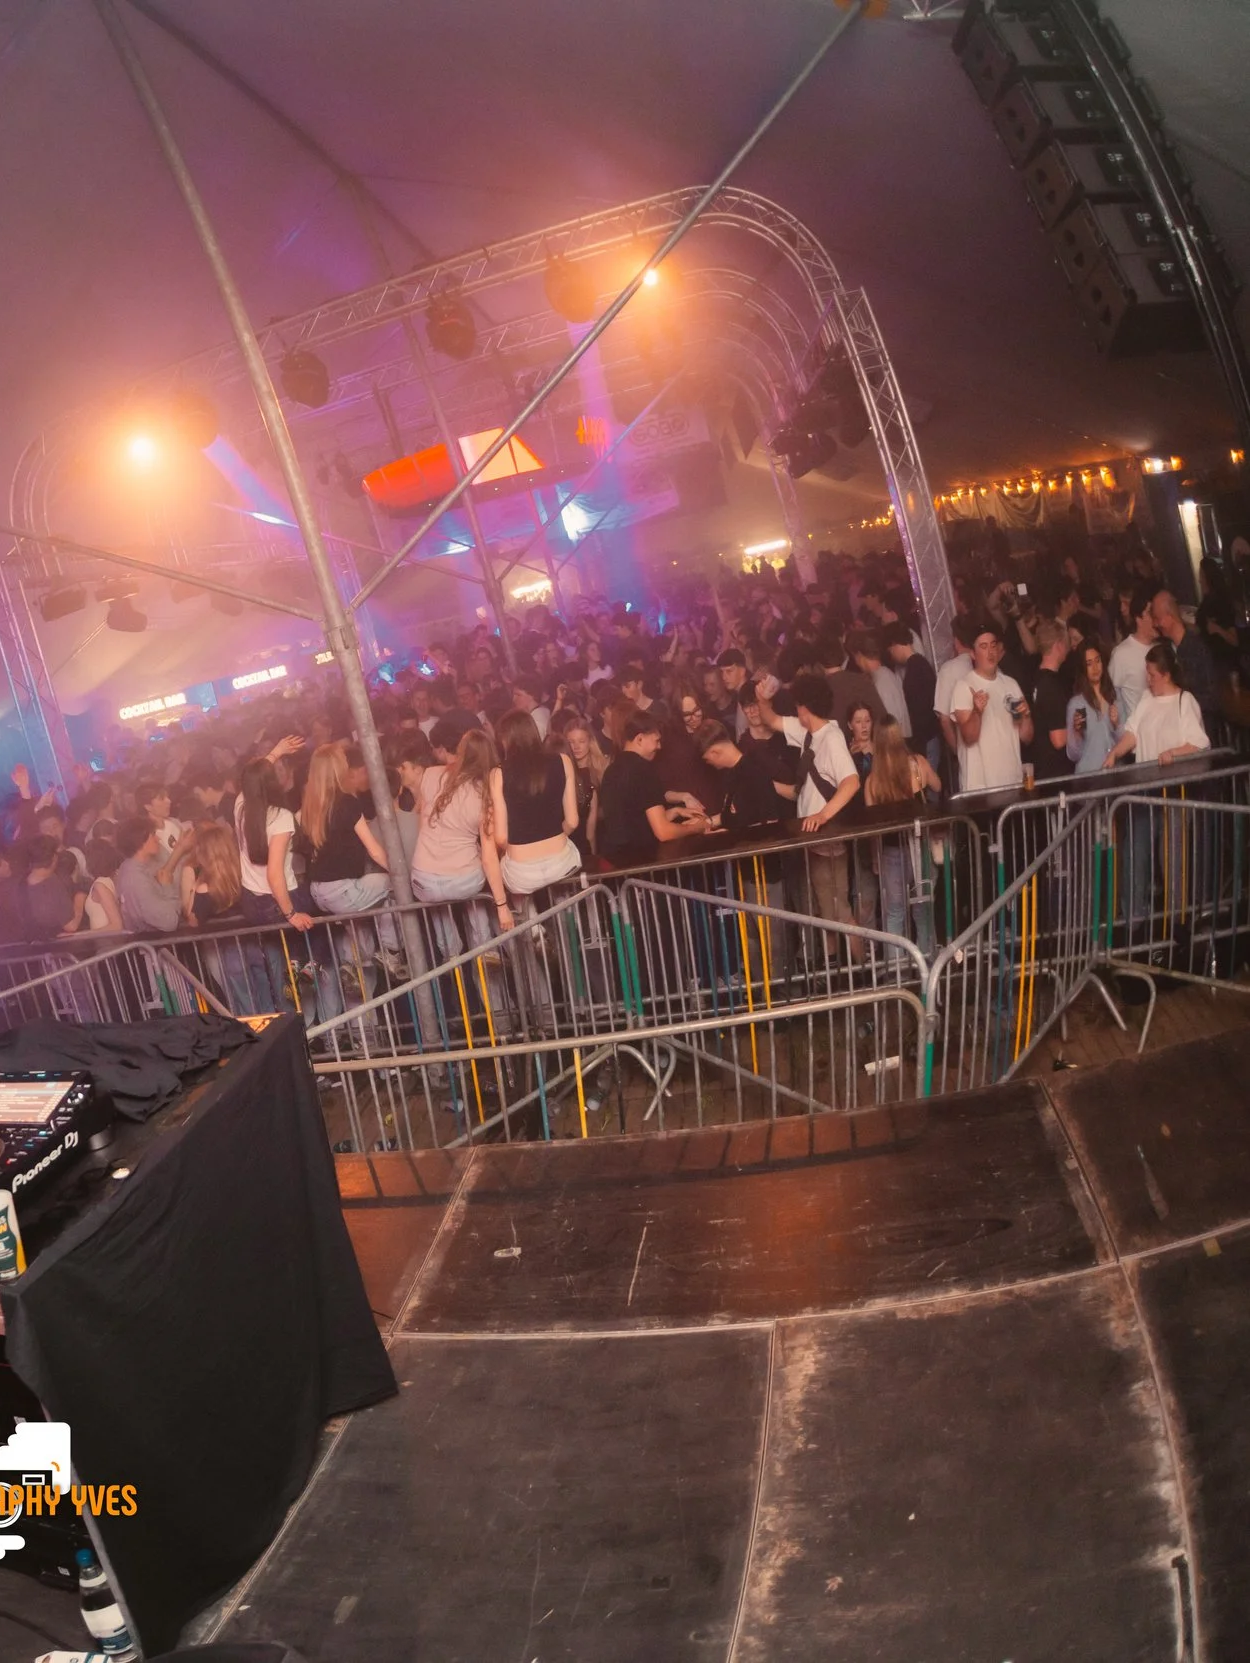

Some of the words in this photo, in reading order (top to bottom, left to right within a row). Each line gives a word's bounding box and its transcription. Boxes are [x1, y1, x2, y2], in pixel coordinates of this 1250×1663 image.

[119, 700, 165, 720] COCKTAIL
[164, 692, 187, 708] BAR
[12, 1144, 63, 1194] Pioneer
